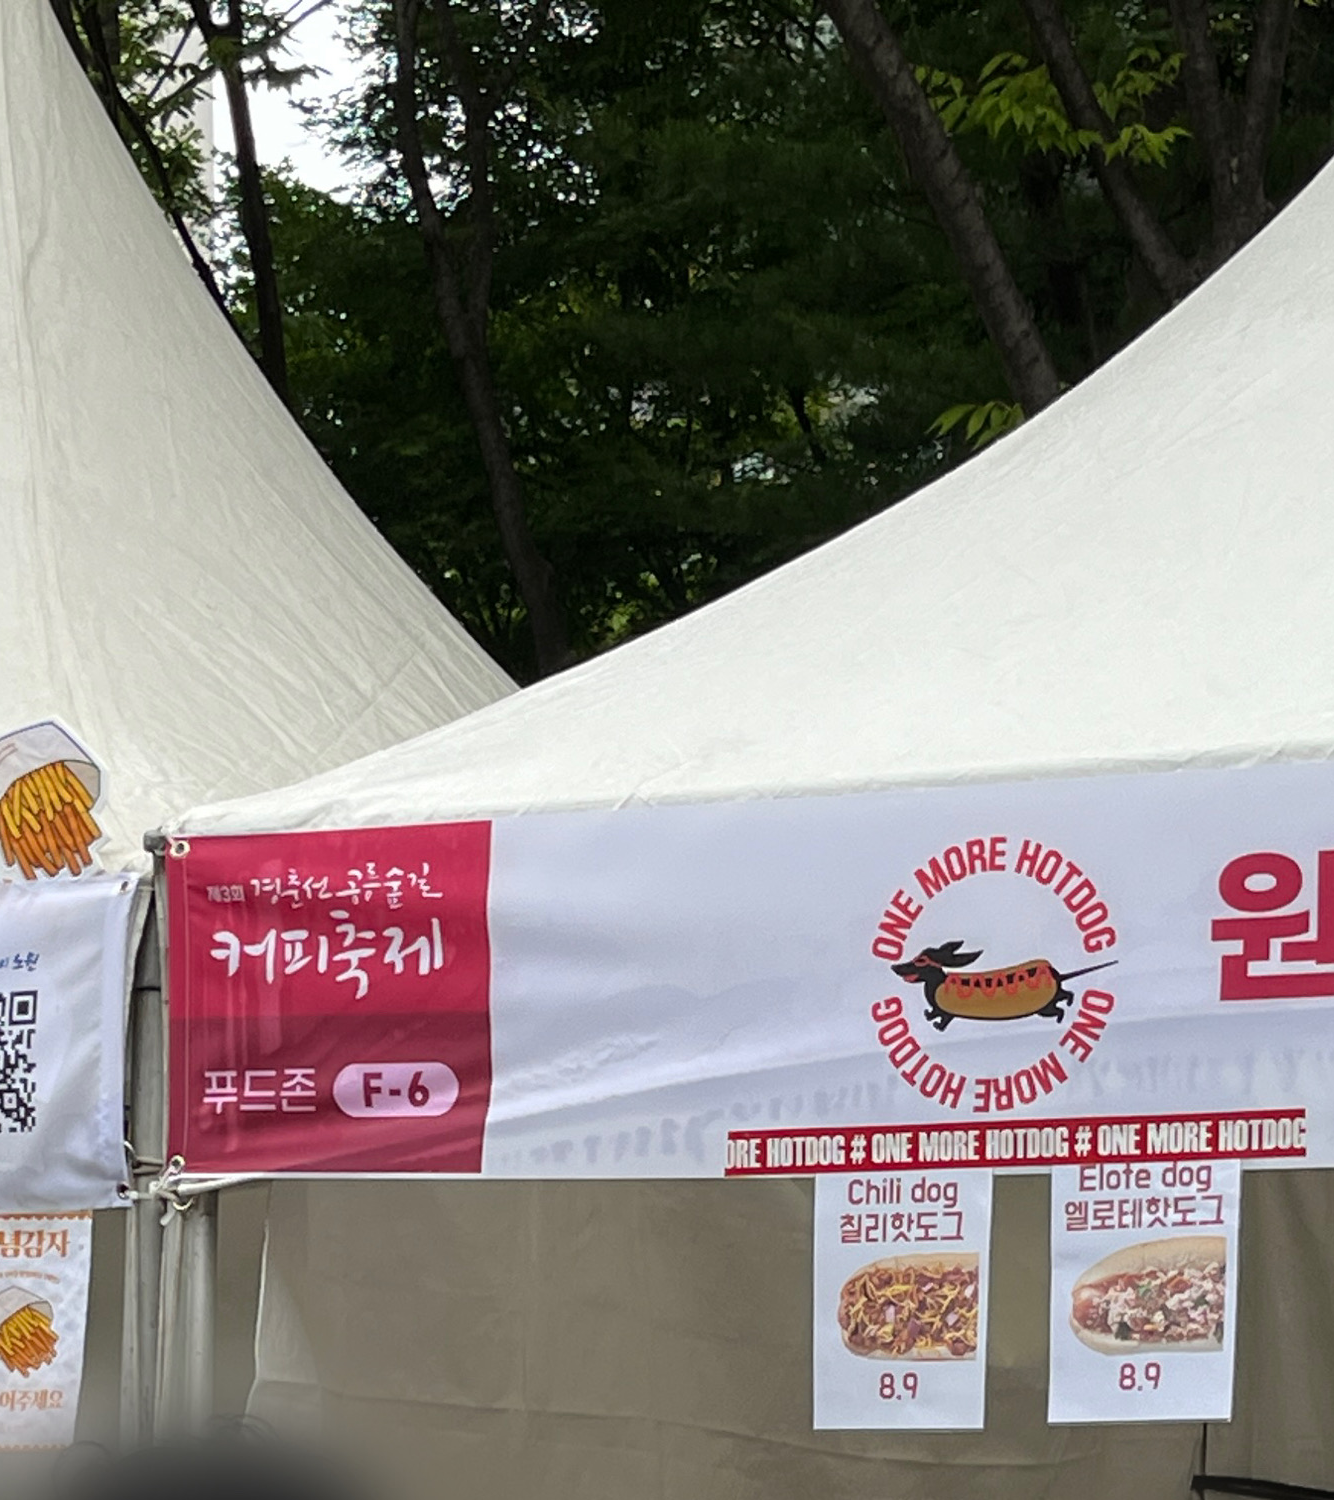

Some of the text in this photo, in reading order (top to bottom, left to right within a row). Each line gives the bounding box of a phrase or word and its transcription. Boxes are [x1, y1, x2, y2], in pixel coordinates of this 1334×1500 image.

[250, 868, 332, 908] 경춘선
[872, 836, 1117, 961] ONE MORE HOTDOG
[210, 910, 444, 1000] 커피축제
[871, 989, 1115, 1113] ONE MORE HOTDOG
[203, 1068, 429, 1114] 푸드존 F-6
[767, 1134, 845, 1168] HOTDOG
[872, 1132, 913, 1164] ONE
[919, 1129, 980, 1162] MORE
[986, 1126, 1069, 1160] HOTDOG
[1098, 1123, 1141, 1156] ONE
[1147, 1121, 1213, 1154] MORE
[1219, 1117, 1306, 1151] HOTDOG
[848, 1176, 958, 1208] Chili dog
[1079, 1161, 1212, 1192] Elote dog
[840, 1211, 964, 1243] 칠리핫도그
[1065, 1194, 1224, 1231] 엘로테핫도그
[879, 1373, 919, 1401] 8.9
[1119, 1363, 1161, 1391] 8.9
